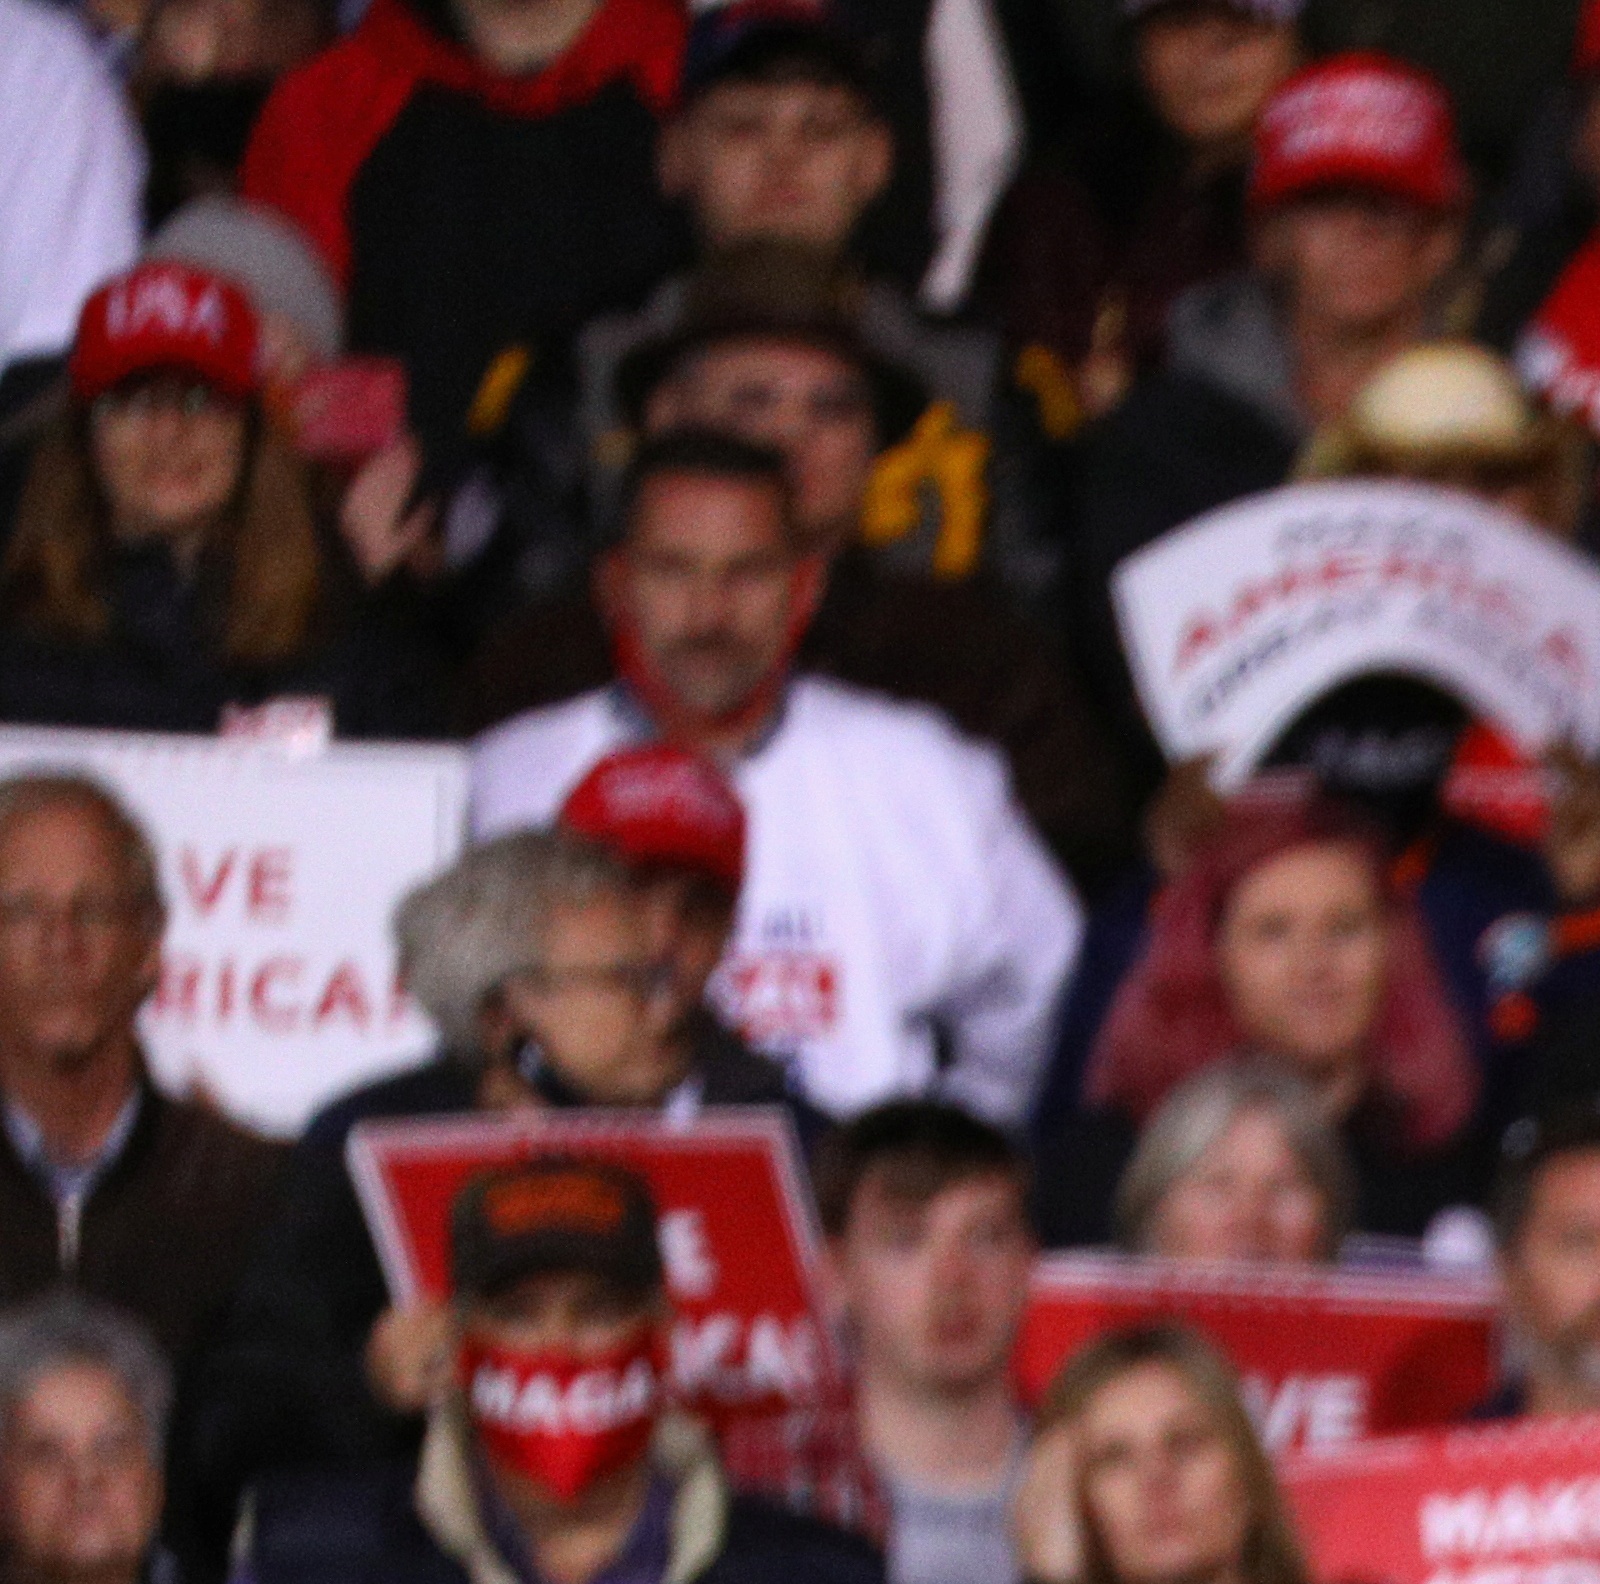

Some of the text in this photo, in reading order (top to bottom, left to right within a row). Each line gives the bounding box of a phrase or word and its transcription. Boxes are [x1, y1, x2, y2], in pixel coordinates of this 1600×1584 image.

[182, 846, 295, 922] VE
[470, 1362, 654, 1434] MAGA
[1252, 1374, 1368, 1450] VE
